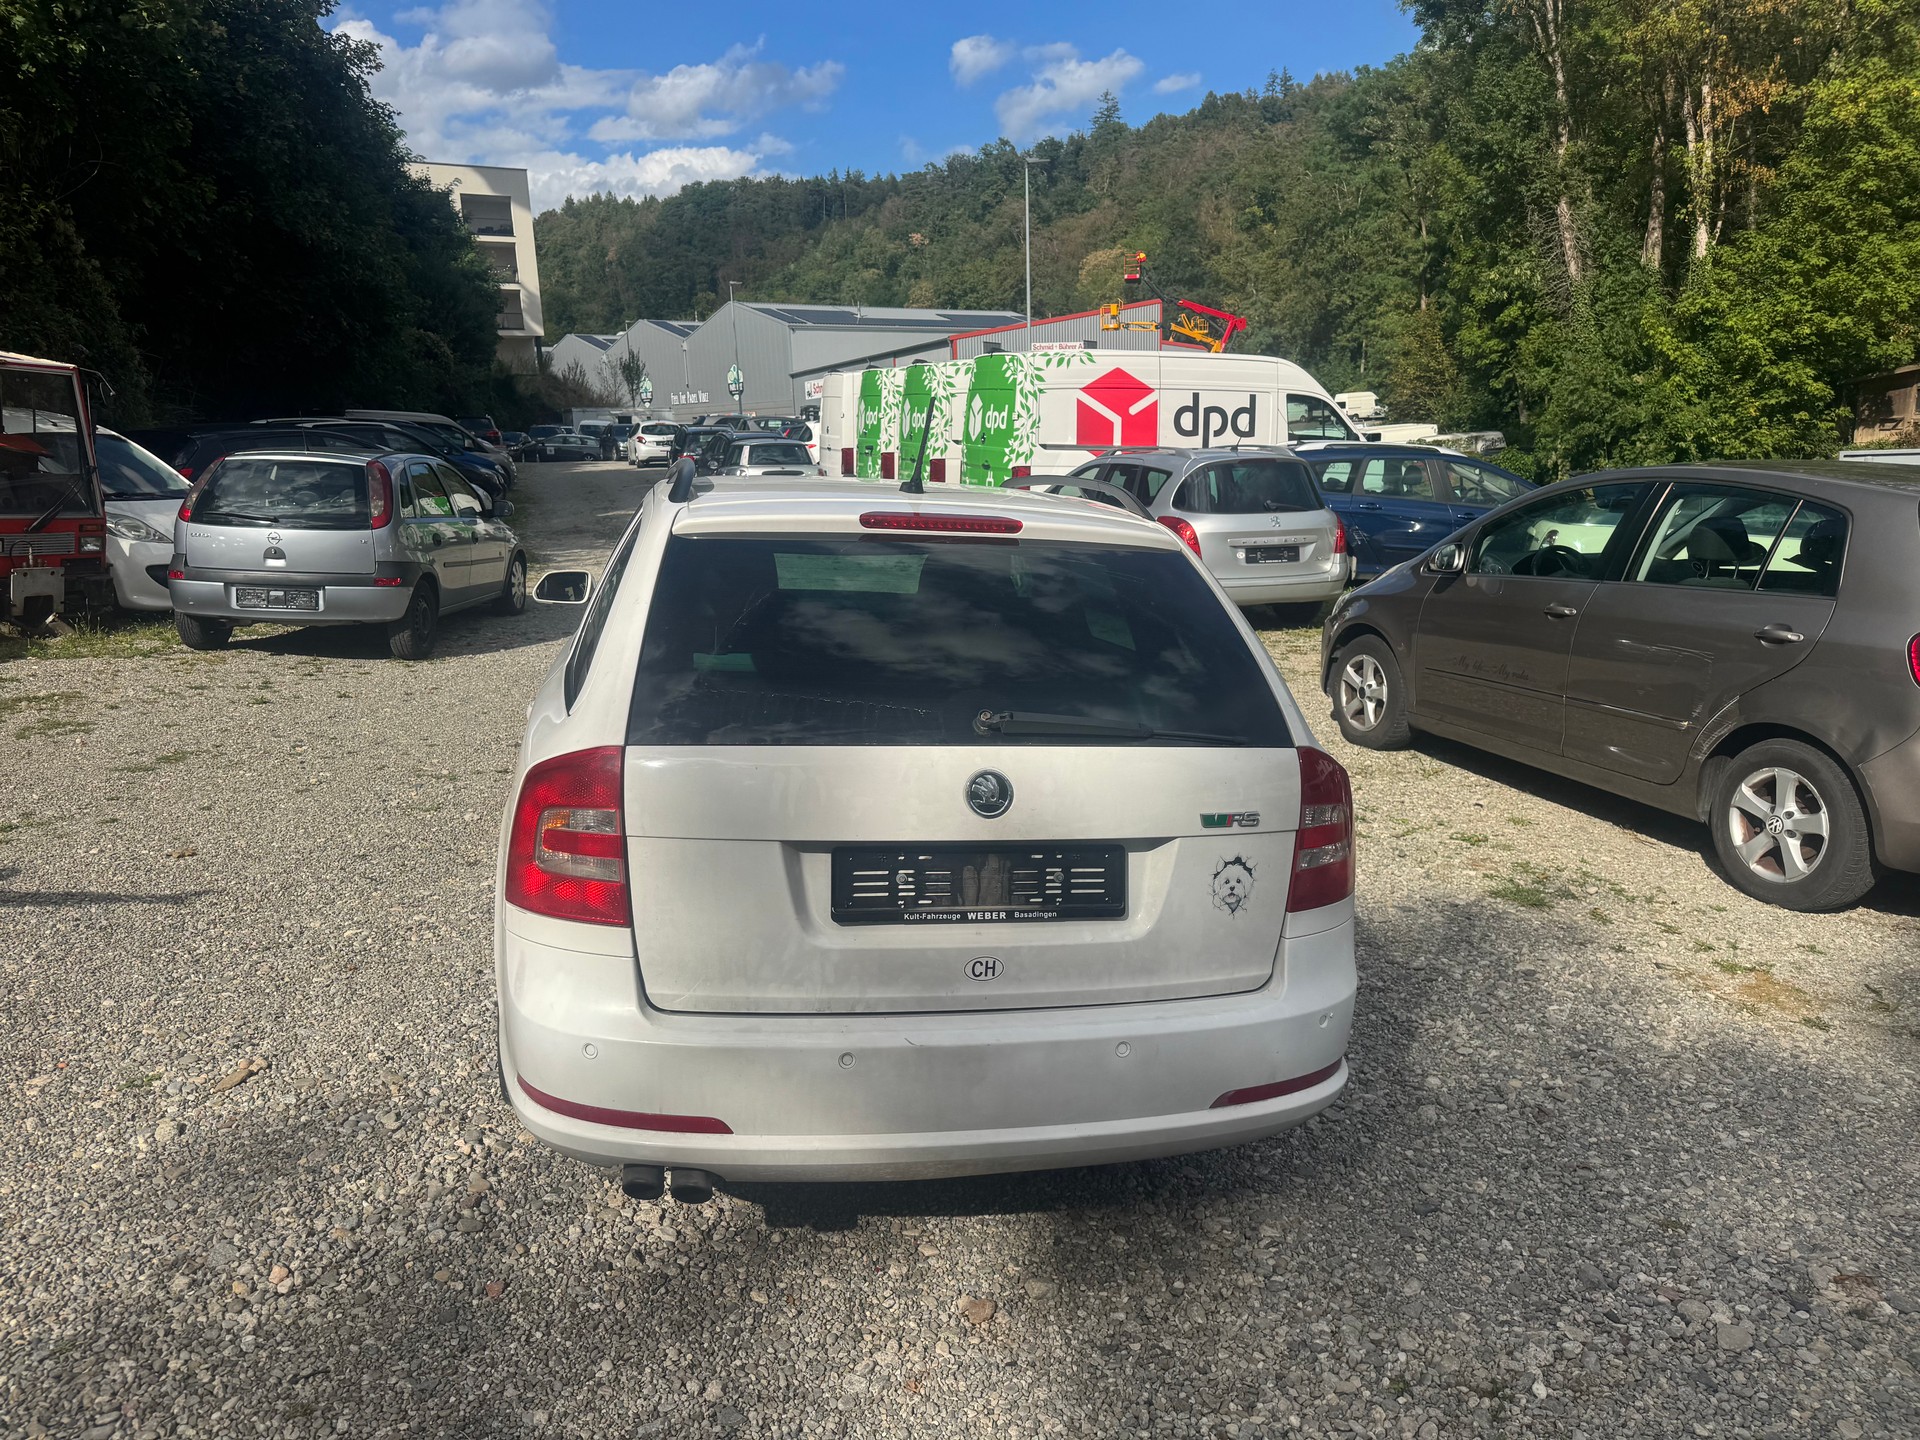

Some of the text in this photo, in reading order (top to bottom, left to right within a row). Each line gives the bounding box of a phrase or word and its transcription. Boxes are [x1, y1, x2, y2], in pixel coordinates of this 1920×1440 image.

[866, 406, 879, 429] dpd
[911, 406, 927, 433] dpd
[985, 403, 1009, 435] dpd
[1174, 392, 1256, 449] dpd
[904, 910, 1057, 921] Kult-Fahrzeuge WEBER Basadingen
[971, 960, 996, 977] CH
